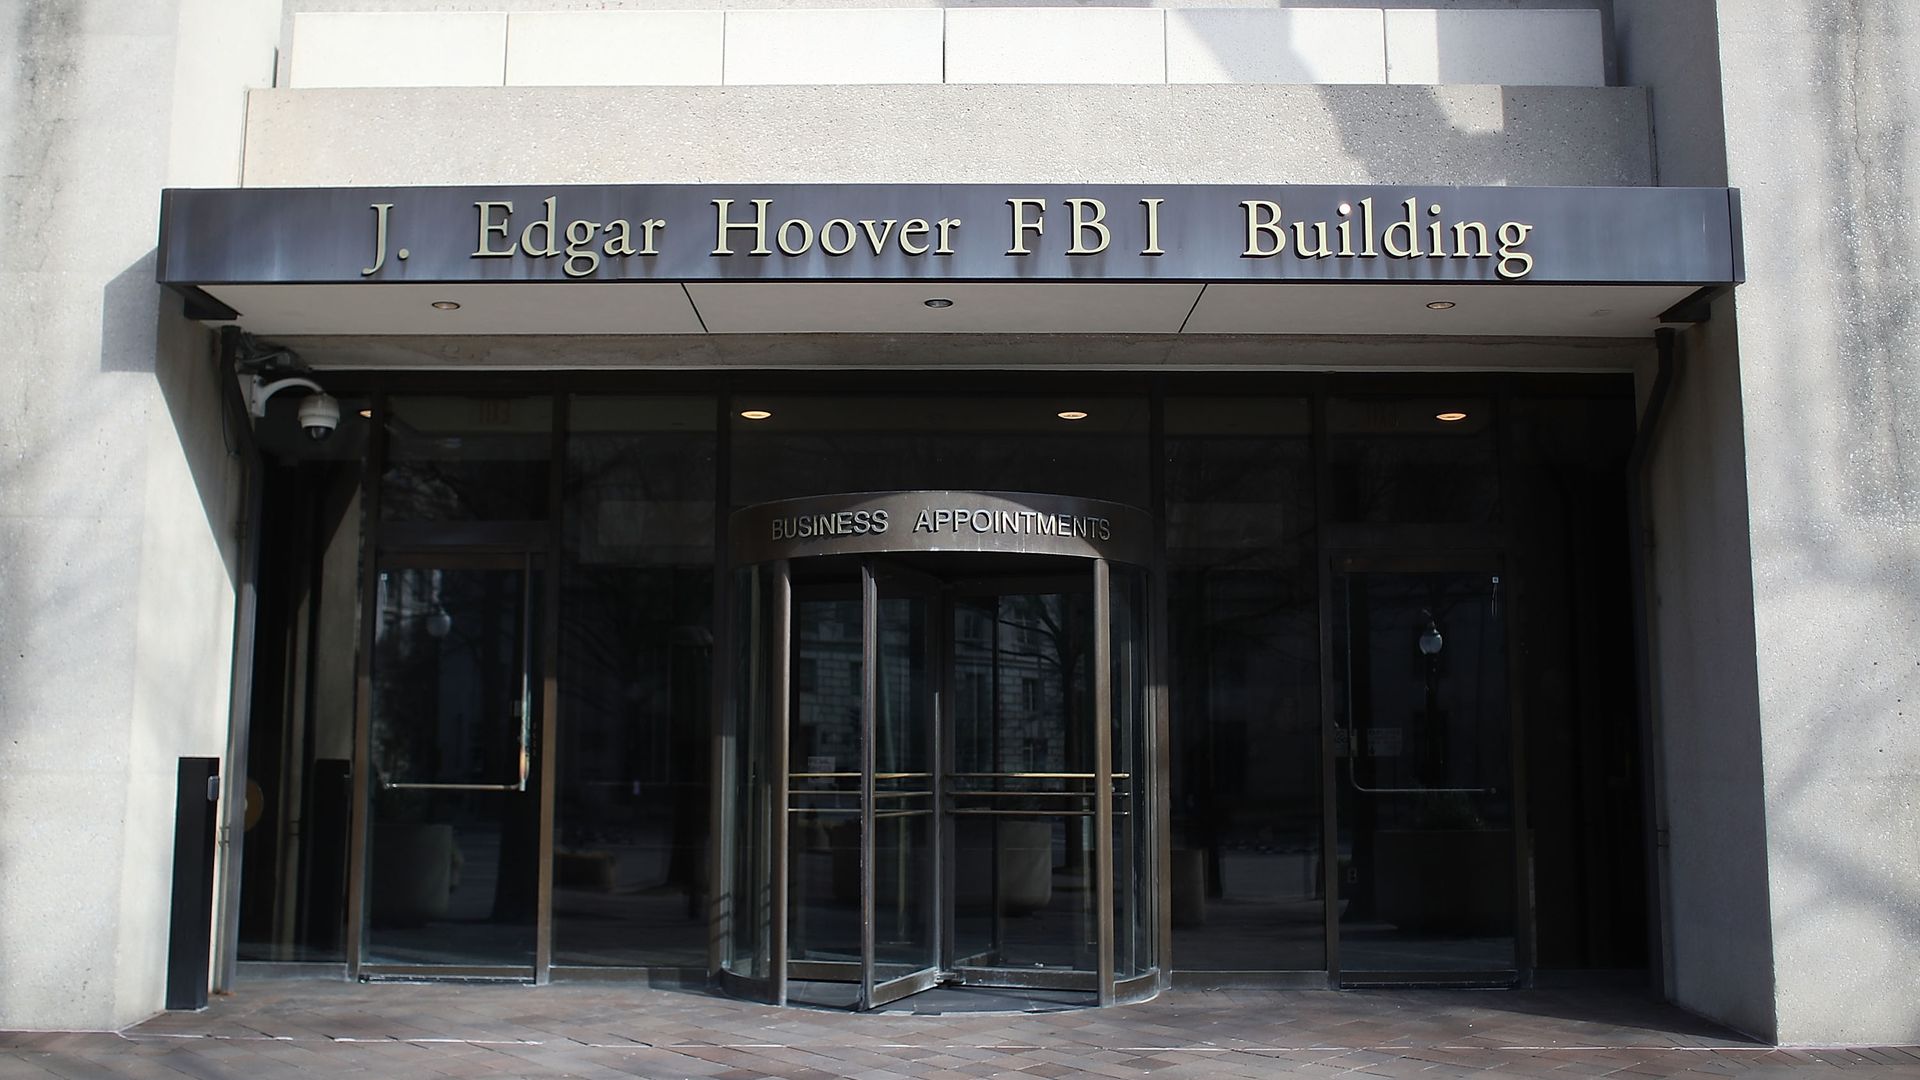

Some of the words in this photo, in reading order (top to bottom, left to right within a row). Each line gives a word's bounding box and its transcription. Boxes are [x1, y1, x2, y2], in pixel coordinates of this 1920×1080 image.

[362, 203, 409, 275] J.
[471, 196, 666, 277] Edgar
[710, 199, 961, 256] Hoover
[1239, 197, 1533, 279] Building
[772, 510, 889, 541] BUSINESS
[912, 509, 1111, 541] APPOINTMENTS
